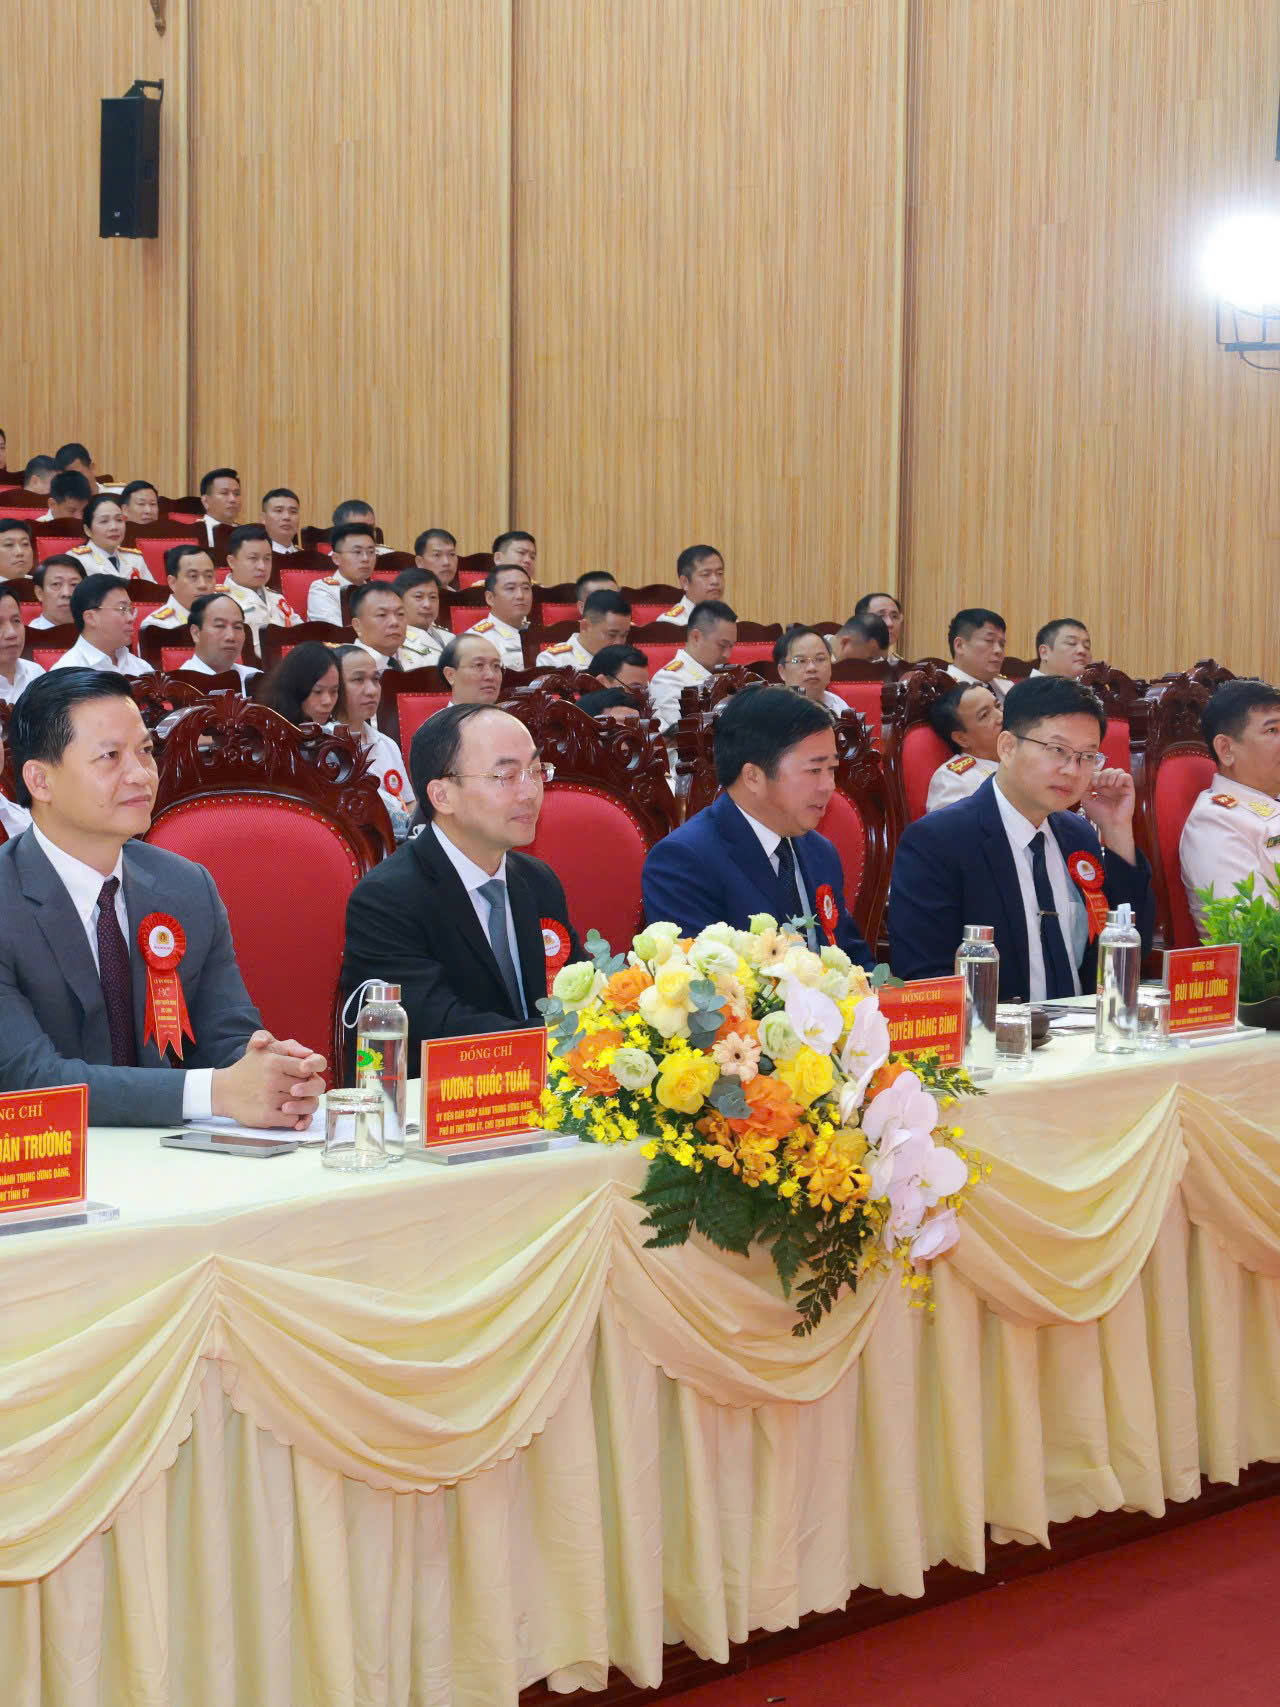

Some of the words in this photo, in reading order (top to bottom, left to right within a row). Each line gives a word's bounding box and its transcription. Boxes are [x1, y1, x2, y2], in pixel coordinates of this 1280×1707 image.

[888, 1013, 914, 1041] GUYỄN
[460, 1045, 491, 1062] ĐỒNG
[493, 1042, 513, 1057] CHÍ
[440, 1076, 474, 1102] VƯƠNG
[476, 1065, 502, 1099] QUỐC
[505, 1062, 530, 1093] TUẤN
[19, 1100, 43, 1119] CHÍ
